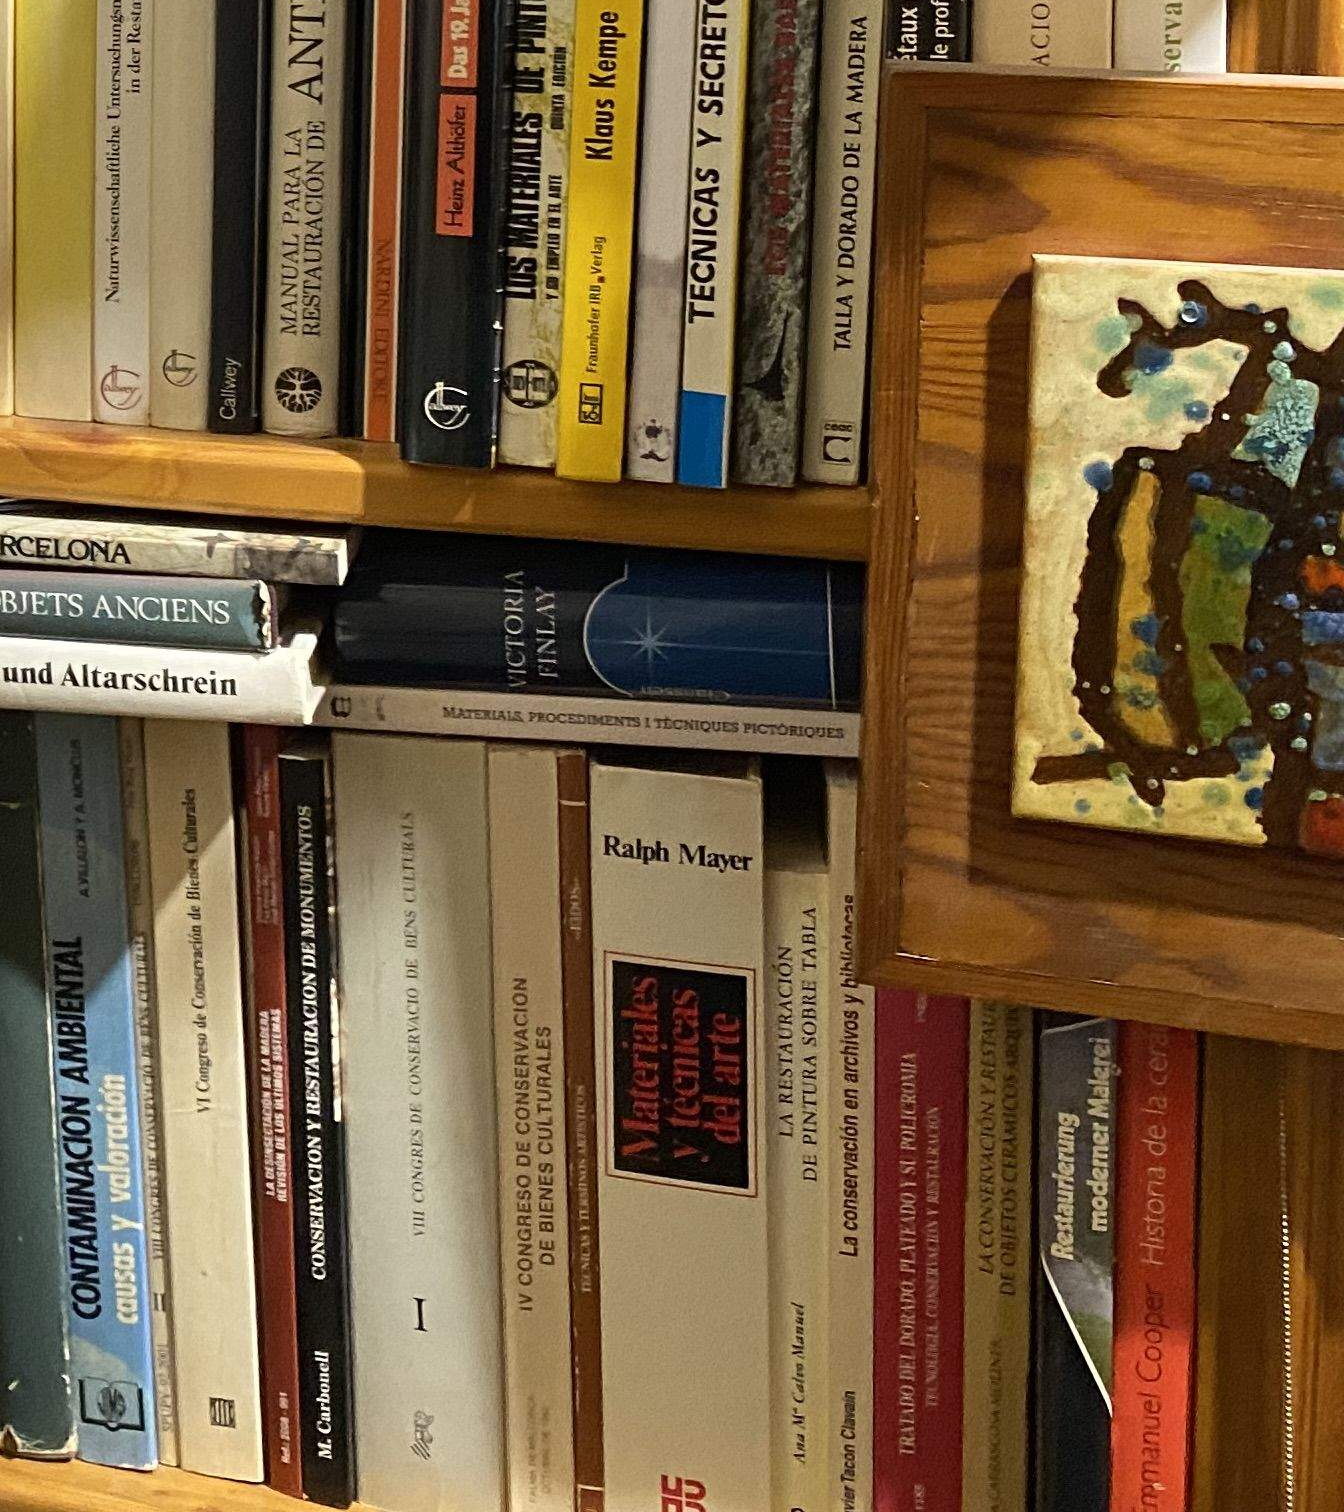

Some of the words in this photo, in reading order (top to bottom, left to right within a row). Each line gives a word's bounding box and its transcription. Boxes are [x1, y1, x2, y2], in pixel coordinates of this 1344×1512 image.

[590, 10, 620, 82] Kempe
[585, 92, 614, 161] Klaus
[696, 129, 720, 153] Y
[688, 167, 722, 324] TECNICAS
[92, 597, 230, 624] ANCIENS
[504, 570, 526, 687] VICTORIA
[536, 586, 557, 677] FINLAY
[1, 660, 54, 685] und
[60, 662, 237, 696] Altarschrein
[602, 836, 670, 864] Ralph
[679, 843, 753, 871] Mayer
[52, 936, 90, 1085] AMBIENTAL
[709, 1014, 740, 1088] arte
[619, 977, 660, 1160] Materiales
[662, 989, 701, 1128] técnicas
[1088, 1037, 1121, 1119] Malerei
[95, 1074, 129, 1200] valoración
[703, 1094, 739, 1145] del
[1141, 1096, 1166, 1117] la
[673, 1141, 709, 1163] y
[1051, 1112, 1079, 1262] Restaurierung
[1086, 1123, 1110, 1233] moderner
[65, 1096, 103, 1320] CONTAMINACION
[112, 1213, 142, 1231] y
[1140, 1173, 1167, 1266] Historia
[108, 1240, 137, 1325] causas
[1135, 1284, 1169, 1382] Cooper
